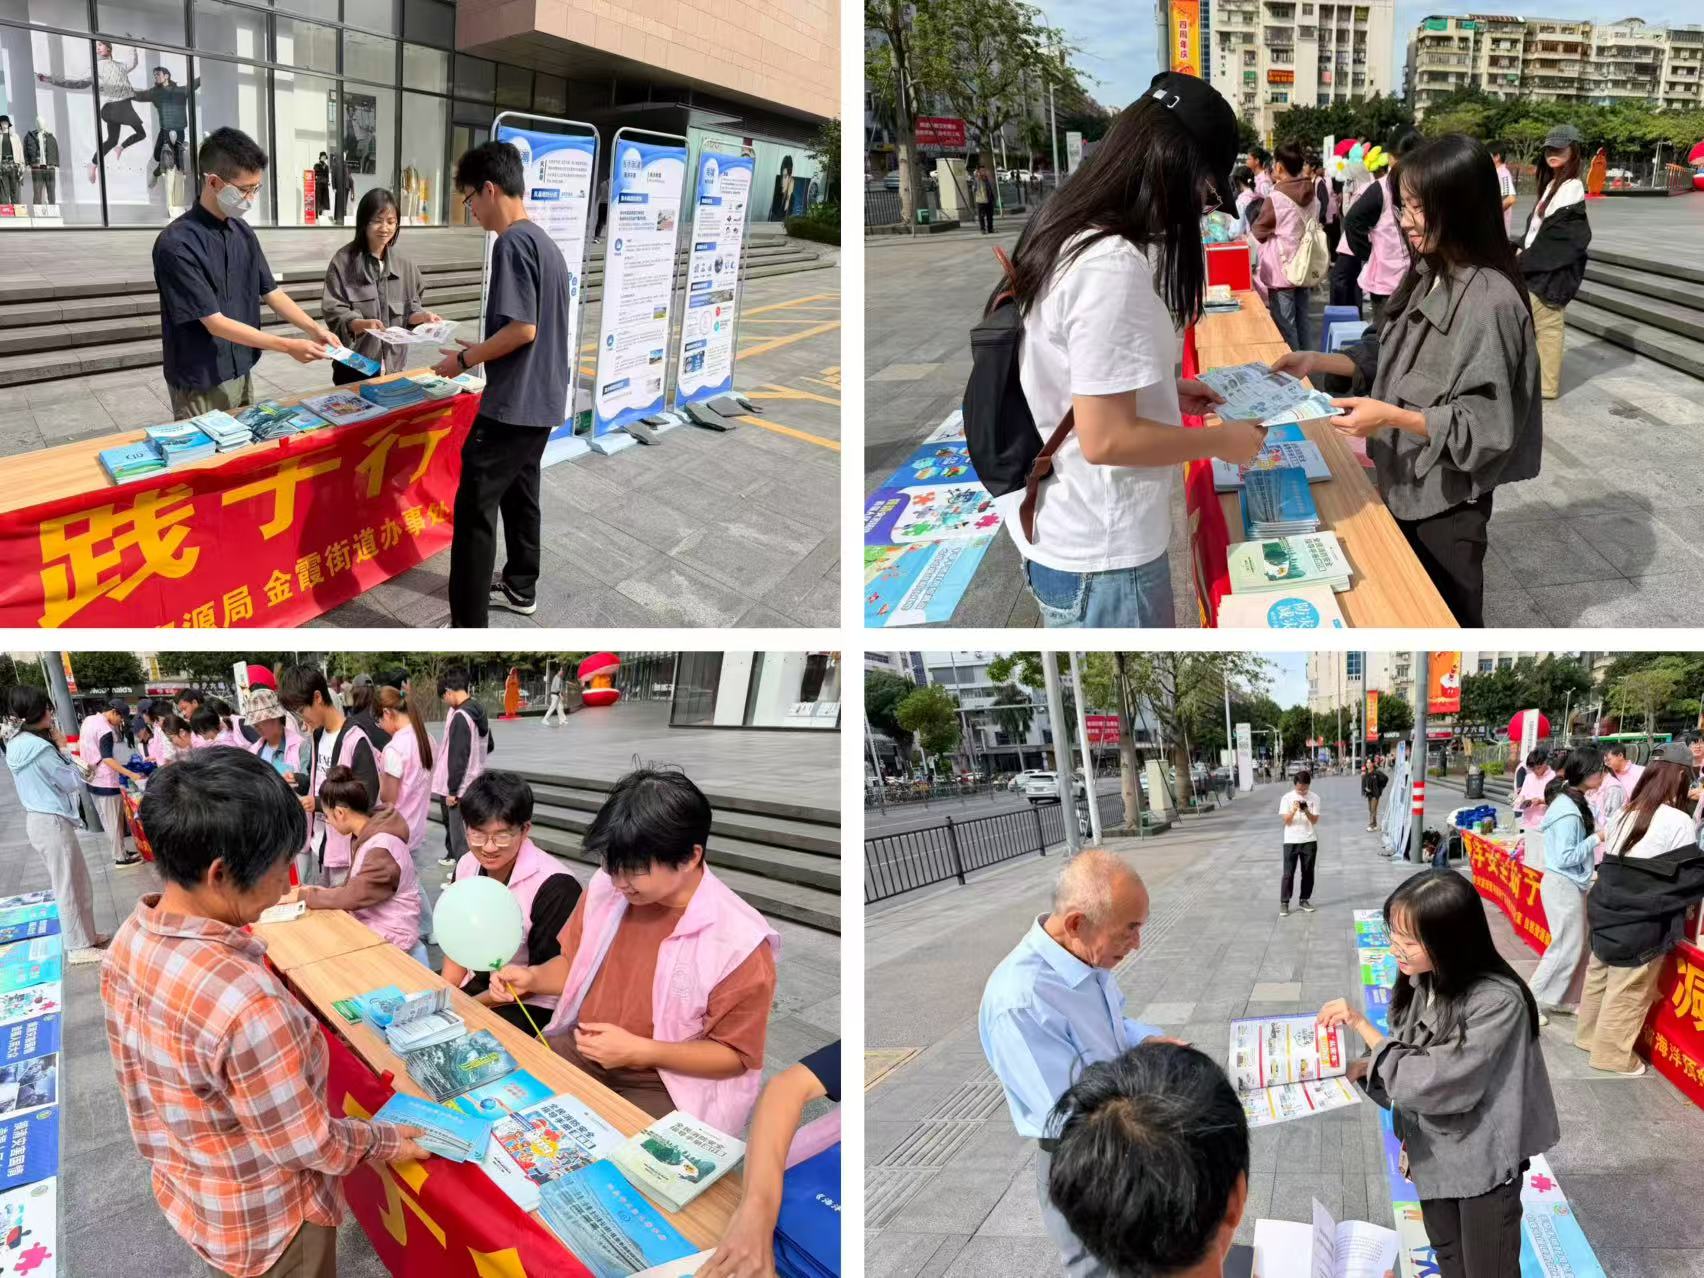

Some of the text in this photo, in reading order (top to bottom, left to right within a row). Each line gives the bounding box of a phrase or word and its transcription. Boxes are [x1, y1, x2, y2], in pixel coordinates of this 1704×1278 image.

[263, 500, 452, 607] 金霞街道办事处
[155, 585, 254, 628] 源局
